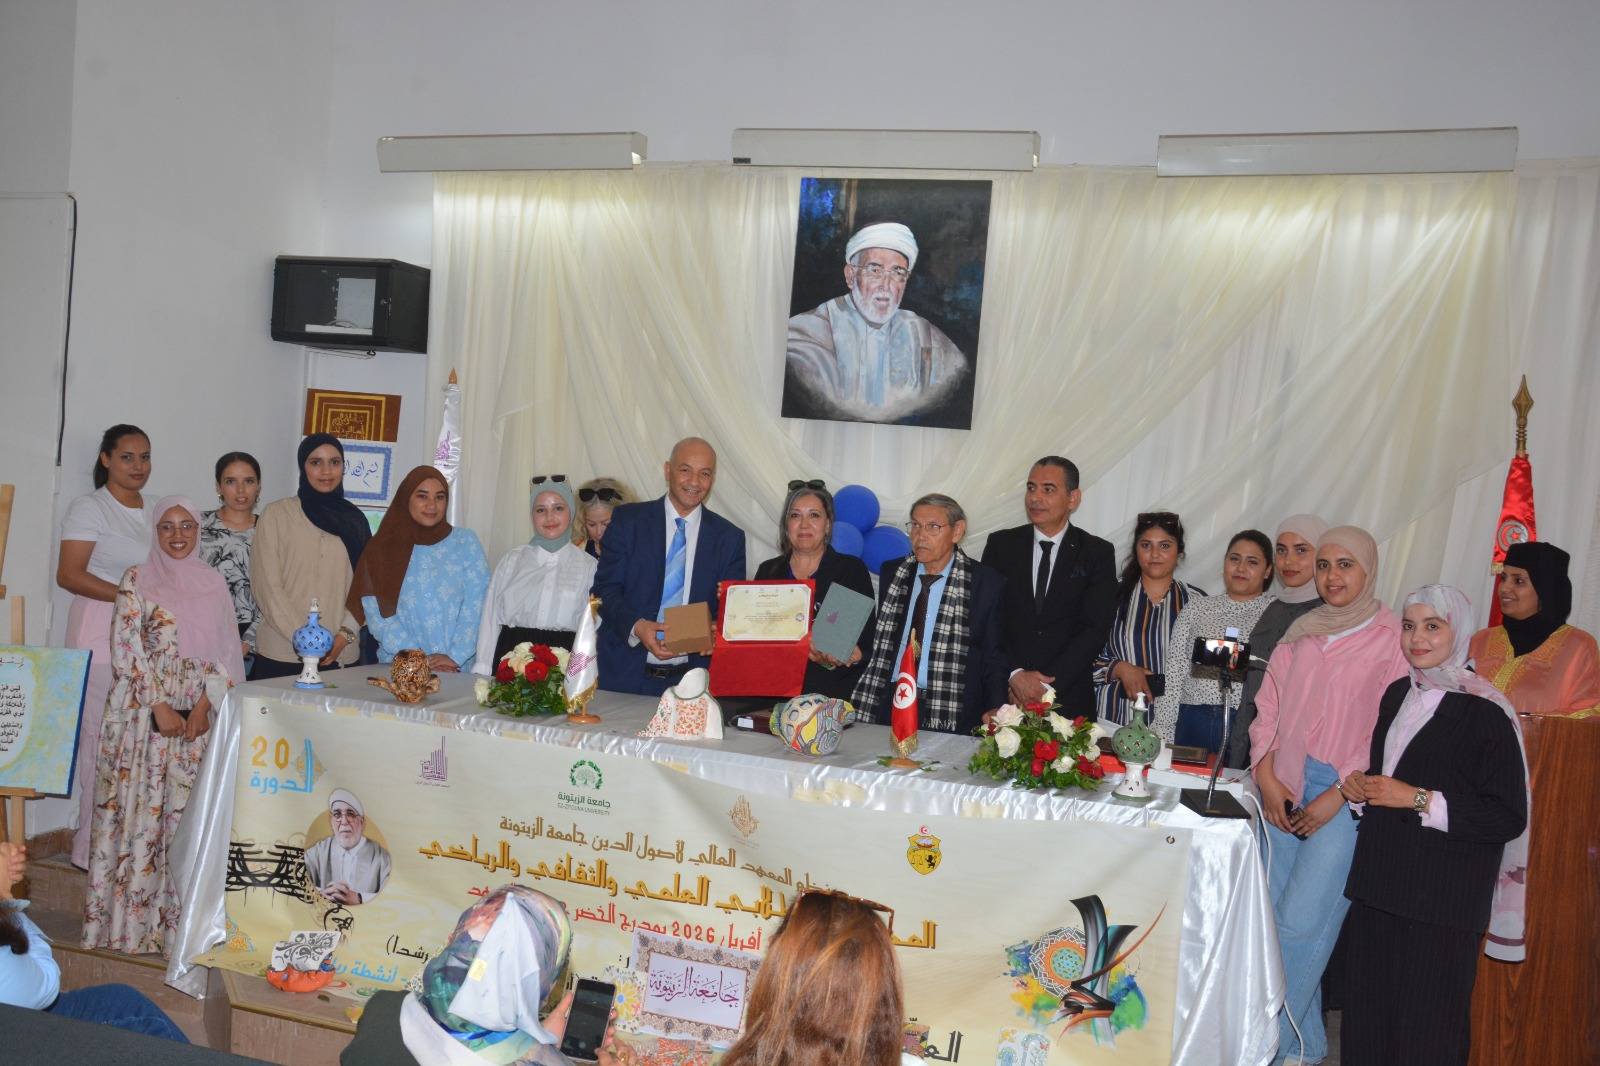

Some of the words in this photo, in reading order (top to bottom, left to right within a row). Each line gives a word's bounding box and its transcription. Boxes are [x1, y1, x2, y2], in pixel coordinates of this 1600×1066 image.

[250, 735, 291, 770] 20
[250, 738, 314, 794] الدورة
[557, 791, 586, 805] الزيتونة
[586, 796, 612, 810] جامعة
[499, 815, 545, 840] الزيتونة
[546, 822, 589, 847] جامعة
[591, 831, 634, 853] الدين
[636, 834, 685, 864] لأصول
[417, 832, 521, 878] والرياضي
[688, 843, 737, 867] العالي
[525, 850, 619, 898] والثقافي
[740, 866, 793, 887] المعهد
[623, 871, 713, 907] العلمي
[573, 901, 616, 925] الخضر
[672, 920, 716, 944] 2026
